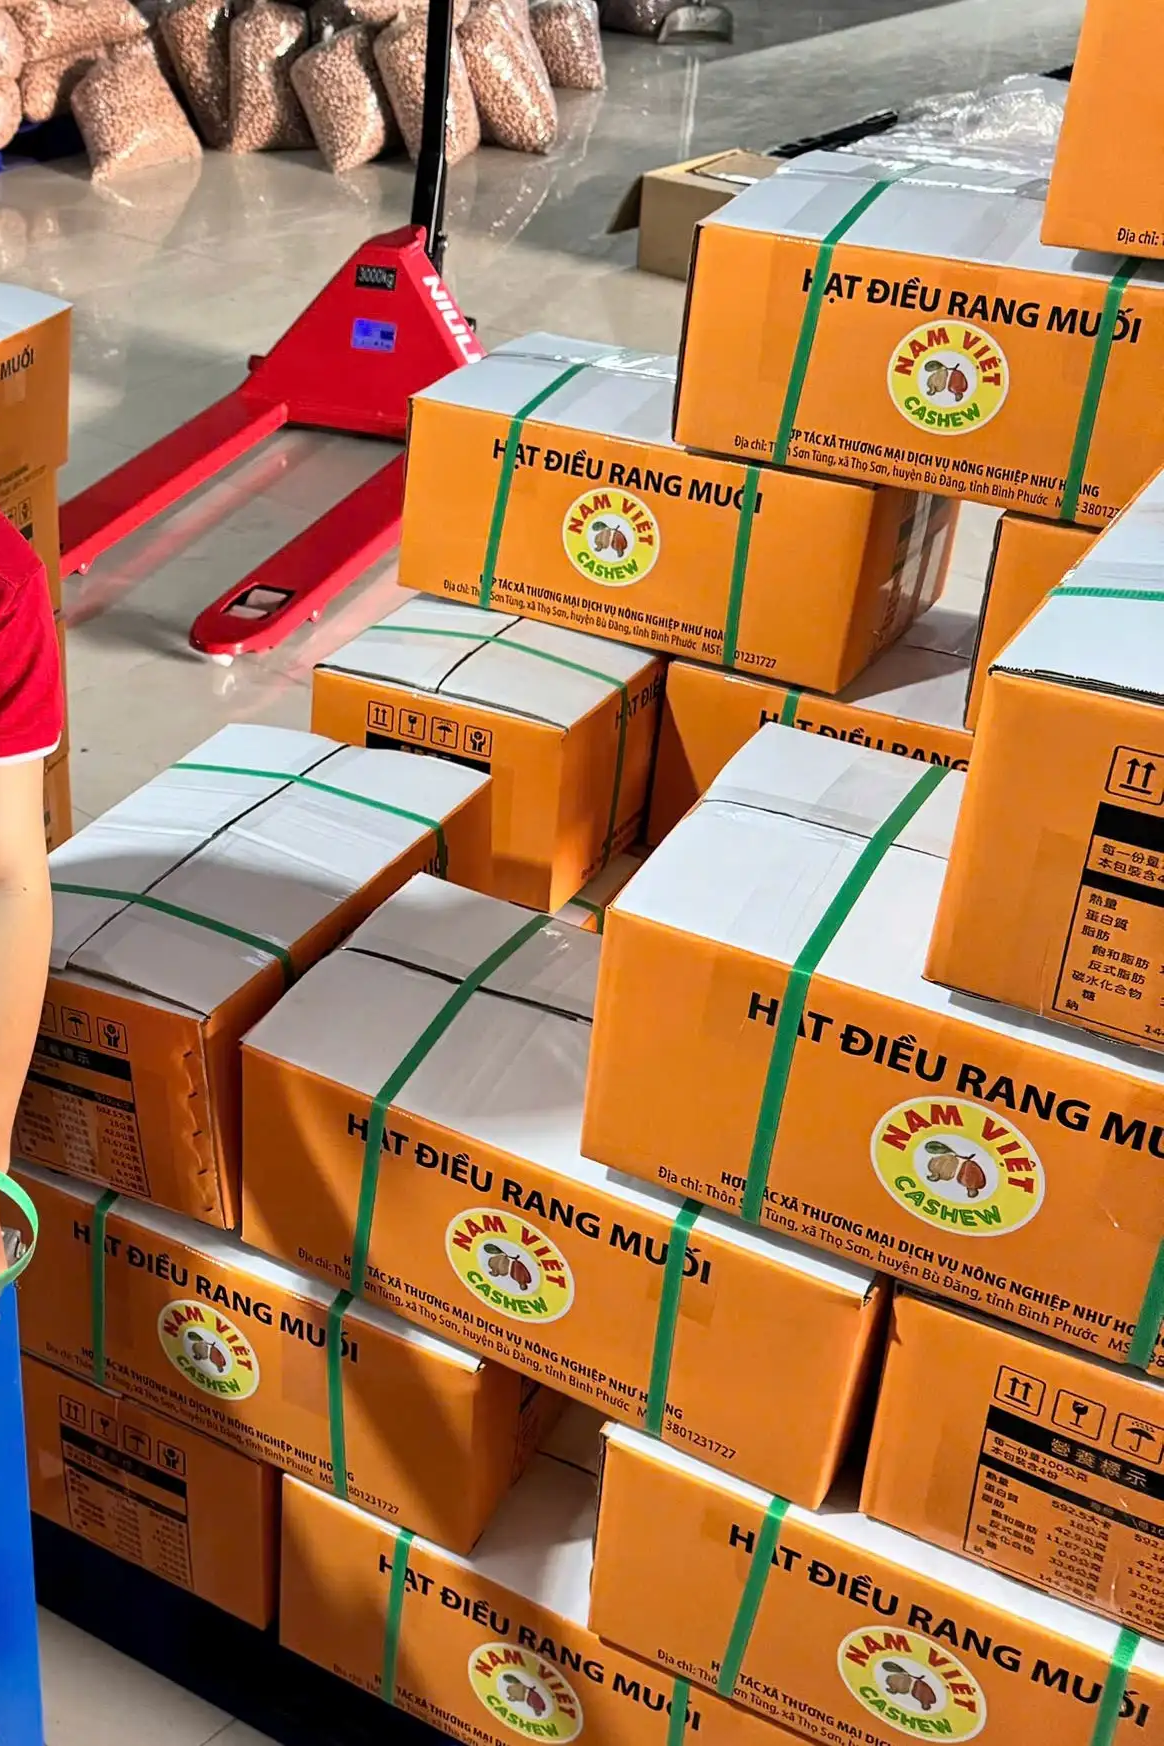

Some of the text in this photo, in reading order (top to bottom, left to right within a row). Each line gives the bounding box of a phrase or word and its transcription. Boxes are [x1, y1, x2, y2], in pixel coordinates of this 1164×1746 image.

[867, 277, 942, 312] ĐIỀU
[947, 291, 1040, 328] RANG
[0, 345, 34, 380] MUỐI
[895, 327, 949, 376] NAM
[905, 396, 980, 427] CASHEW
[544, 449, 603, 481] ĐIỀU
[609, 465, 682, 498] RANG
[804, 431, 1058, 490] TÁC XÃ THƯƠNG MẠI DỊCH VỤ NÔNG NGHIỆP NHƯ
[567, 494, 612, 535] NAM
[575, 551, 639, 580] CASHEW
[1081, 925, 1110, 942] 脂肪
[1085, 909, 1129, 931] 蛋白質
[1088, 960, 1145, 985] 反式脂肪
[1092, 945, 1149, 970] 飽和脂肪
[1072, 969, 1143, 1000] 碳水化合物
[840, 1024, 948, 1084] ĐIỀU
[956, 1063, 1091, 1132] RANG
[1099, 1111, 1164, 1159] MU
[882, 1104, 964, 1151] NAM
[414, 1143, 494, 1193] ĐIỀU
[501, 1181, 601, 1239] RANG
[894, 1176, 1001, 1226] CASHEW
[453, 1214, 507, 1252] NAM
[658, 1166, 1099, 1343] Địa chỉ: Thôn Tùng, xã Thọ Sơn, huyện Bù Đăng, tỉnh Bình Phước
[127, 1245, 188, 1288] ĐIỀU
[195, 1277, 273, 1325] RANG
[466, 1269, 549, 1317] CASHEW
[163, 1306, 204, 1338] NAM
[176, 1355, 241, 1394] CASHEW
[440, 1586, 510, 1635] ĐIỀU
[518, 1625, 604, 1684] RANG
[807, 1565, 899, 1617] ĐIỀU
[907, 1605, 1022, 1673] RANG
[475, 1648, 525, 1678] NAM
[845, 1632, 912, 1668] NAM
[486, 1695, 559, 1737] CASHEW
[859, 1685, 953, 1735] CASHEW
